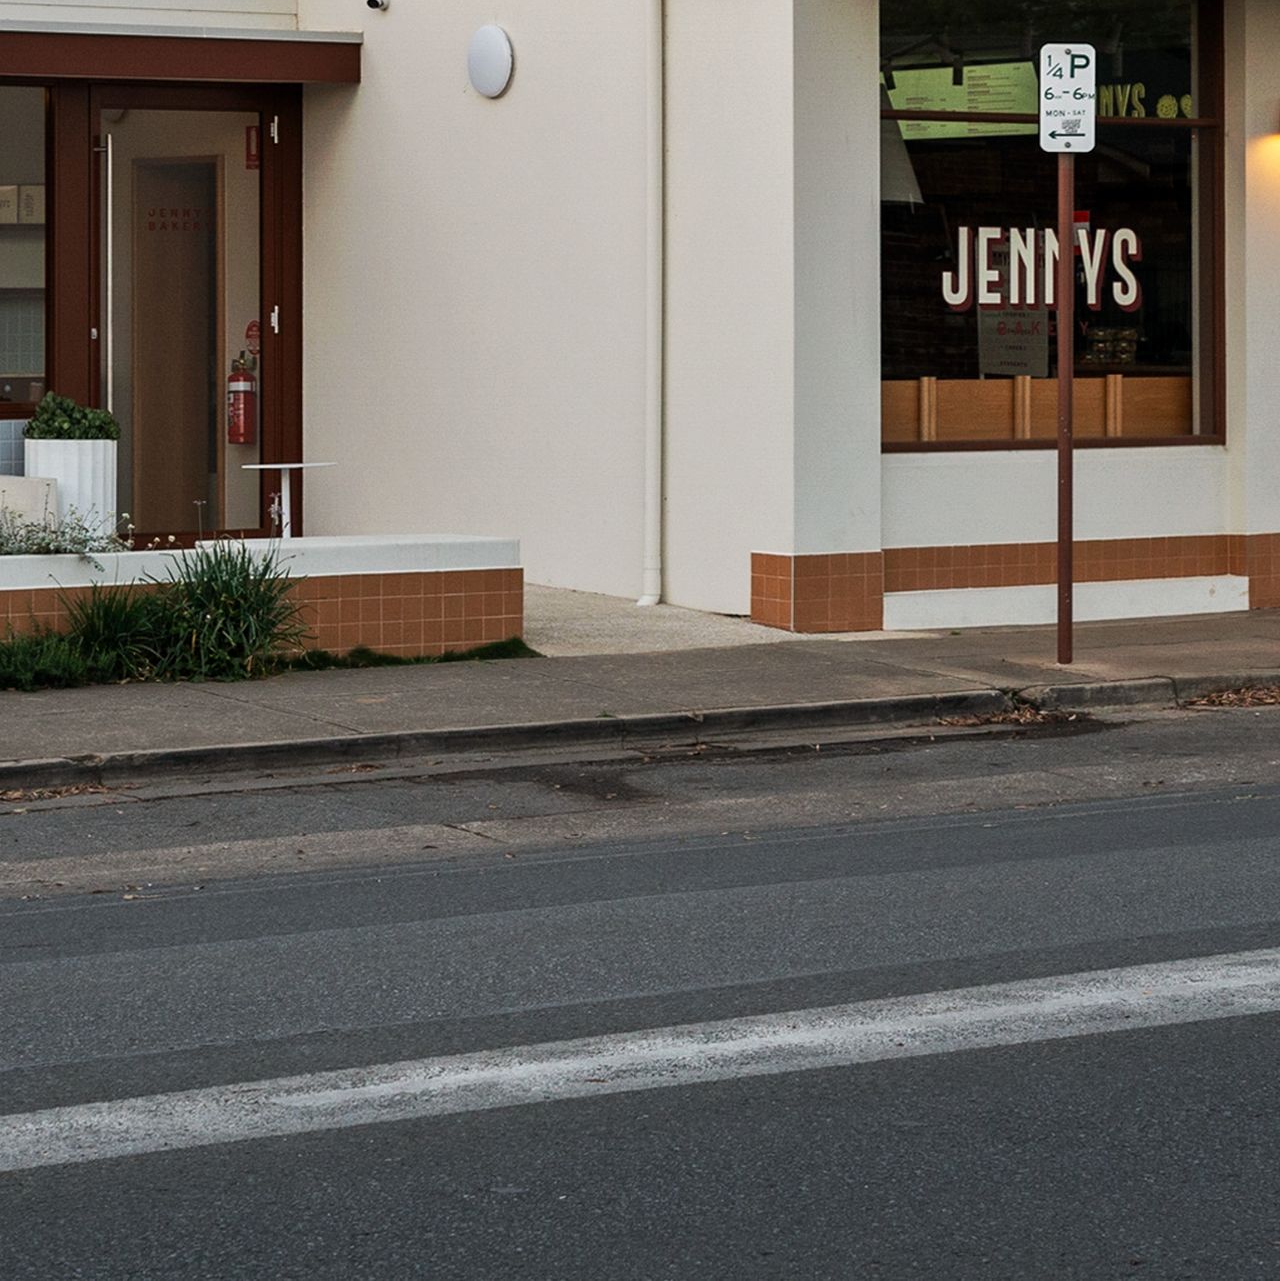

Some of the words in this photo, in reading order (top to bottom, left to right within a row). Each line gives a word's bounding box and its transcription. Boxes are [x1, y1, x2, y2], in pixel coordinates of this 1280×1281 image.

[1070, 54, 1090, 78] P
[1100, 82, 1145, 118] NYS
[942, 226, 1142, 312] JENNYS
[997, 321, 1089, 336] BAKEY
